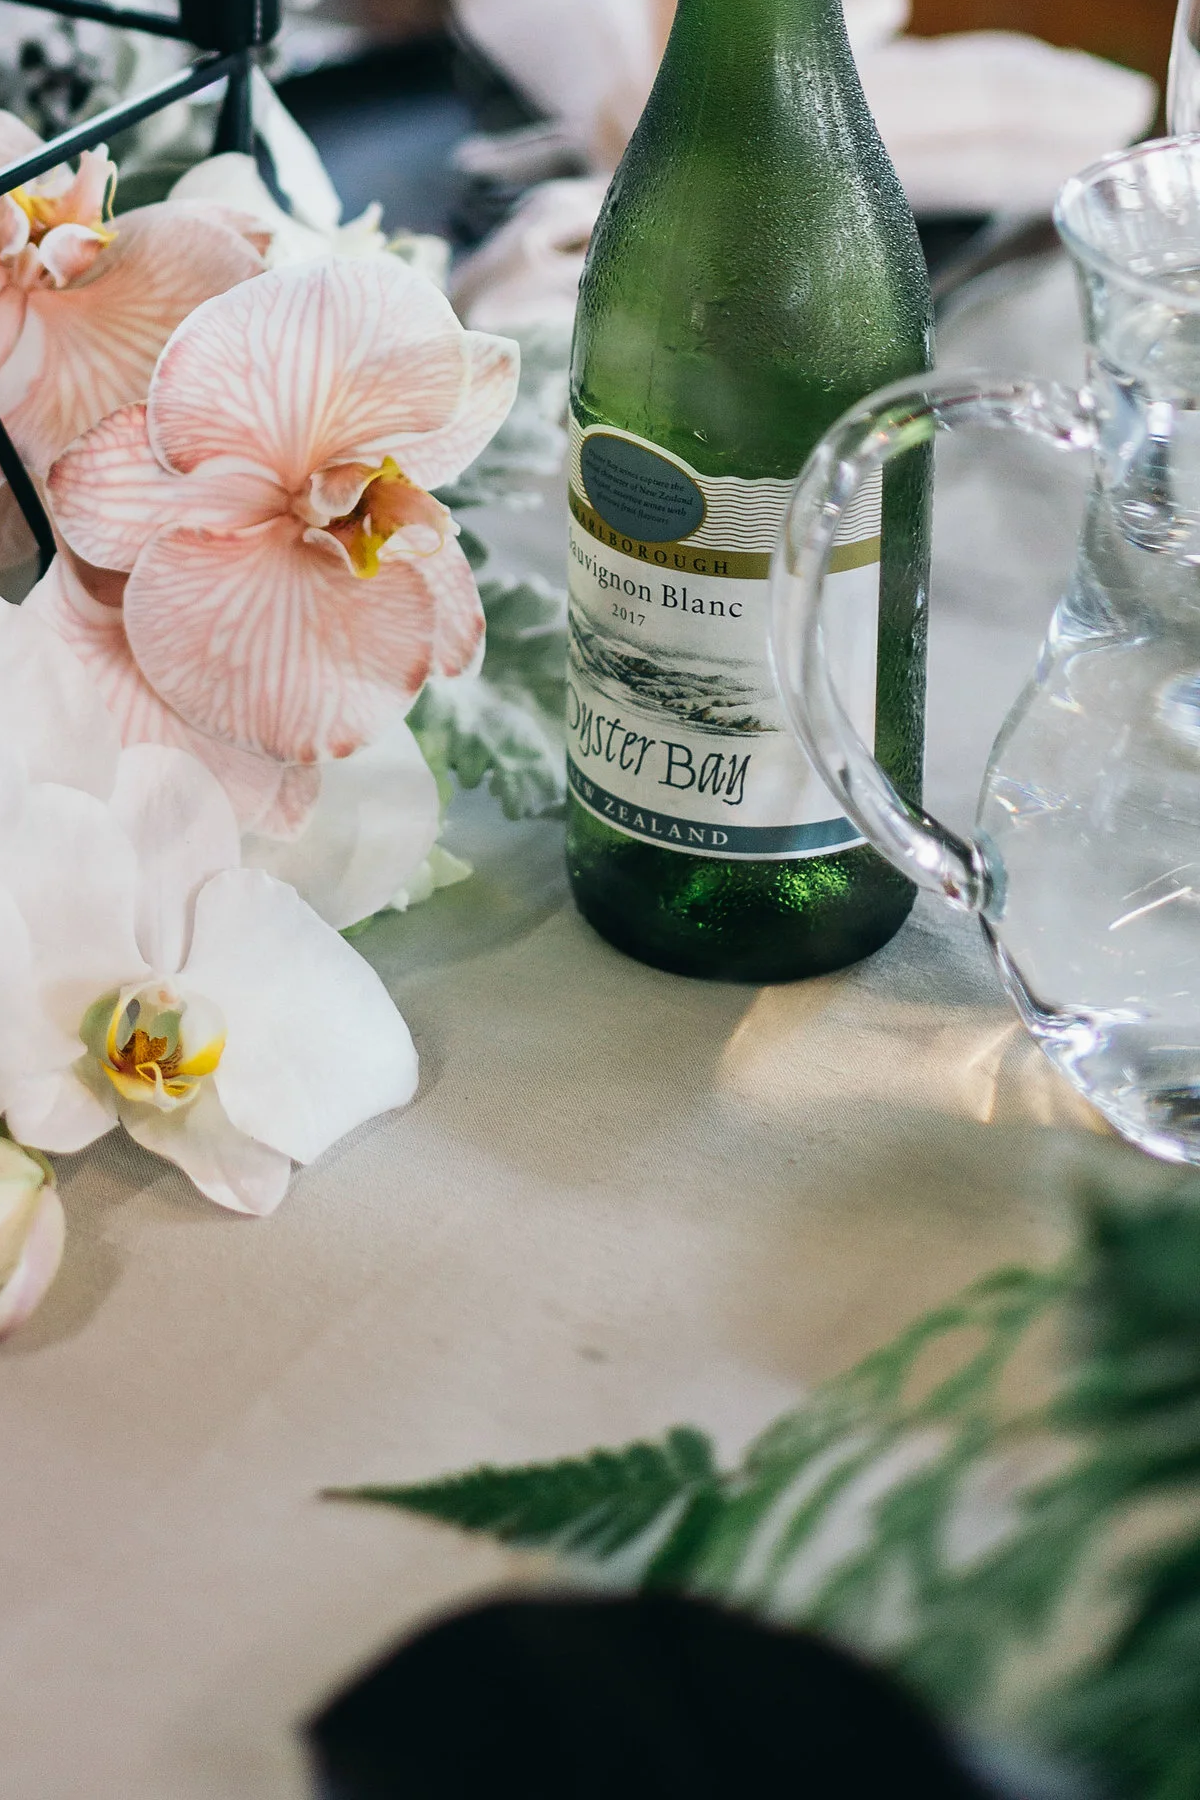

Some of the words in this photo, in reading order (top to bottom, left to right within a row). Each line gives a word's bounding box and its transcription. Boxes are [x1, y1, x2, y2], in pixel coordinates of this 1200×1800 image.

[639, 485, 657, 497] New
[658, 490, 694, 506] Zealand
[640, 475, 669, 488] capture
[670, 481, 685, 491] the
[643, 499, 666, 511] wines
[667, 505, 687, 516] with
[572, 502, 730, 575] MARLBOROUGH
[612, 603, 646, 626] 2017
[661, 583, 744, 618] Blanc
[658, 739, 752, 806] Bay
[604, 798, 729, 846] ZEALAND
